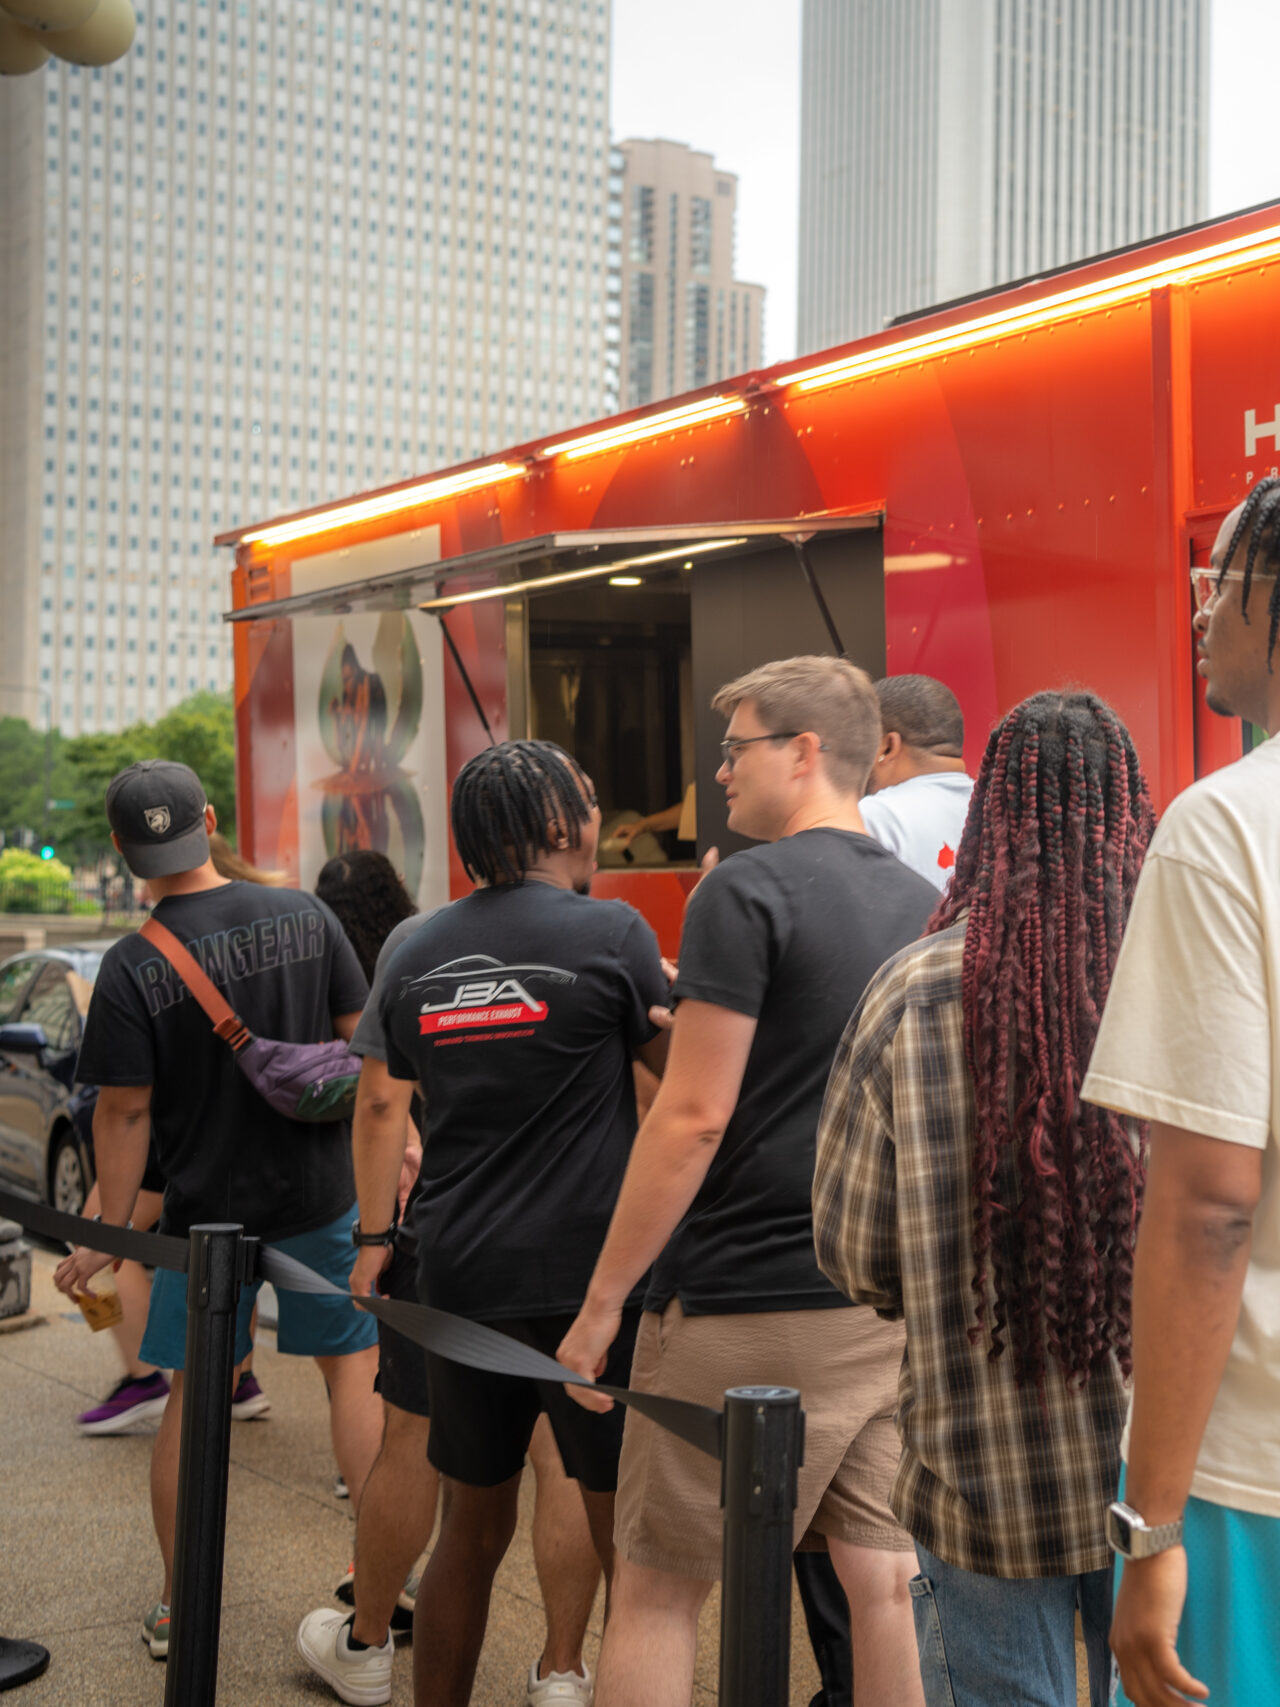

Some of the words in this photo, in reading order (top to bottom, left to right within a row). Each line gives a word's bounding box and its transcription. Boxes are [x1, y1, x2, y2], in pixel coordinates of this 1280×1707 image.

[420, 978, 544, 1013] JBA
[437, 1010, 490, 1027] PERFORMANCE
[489, 1006, 524, 1021] EXHAUST
